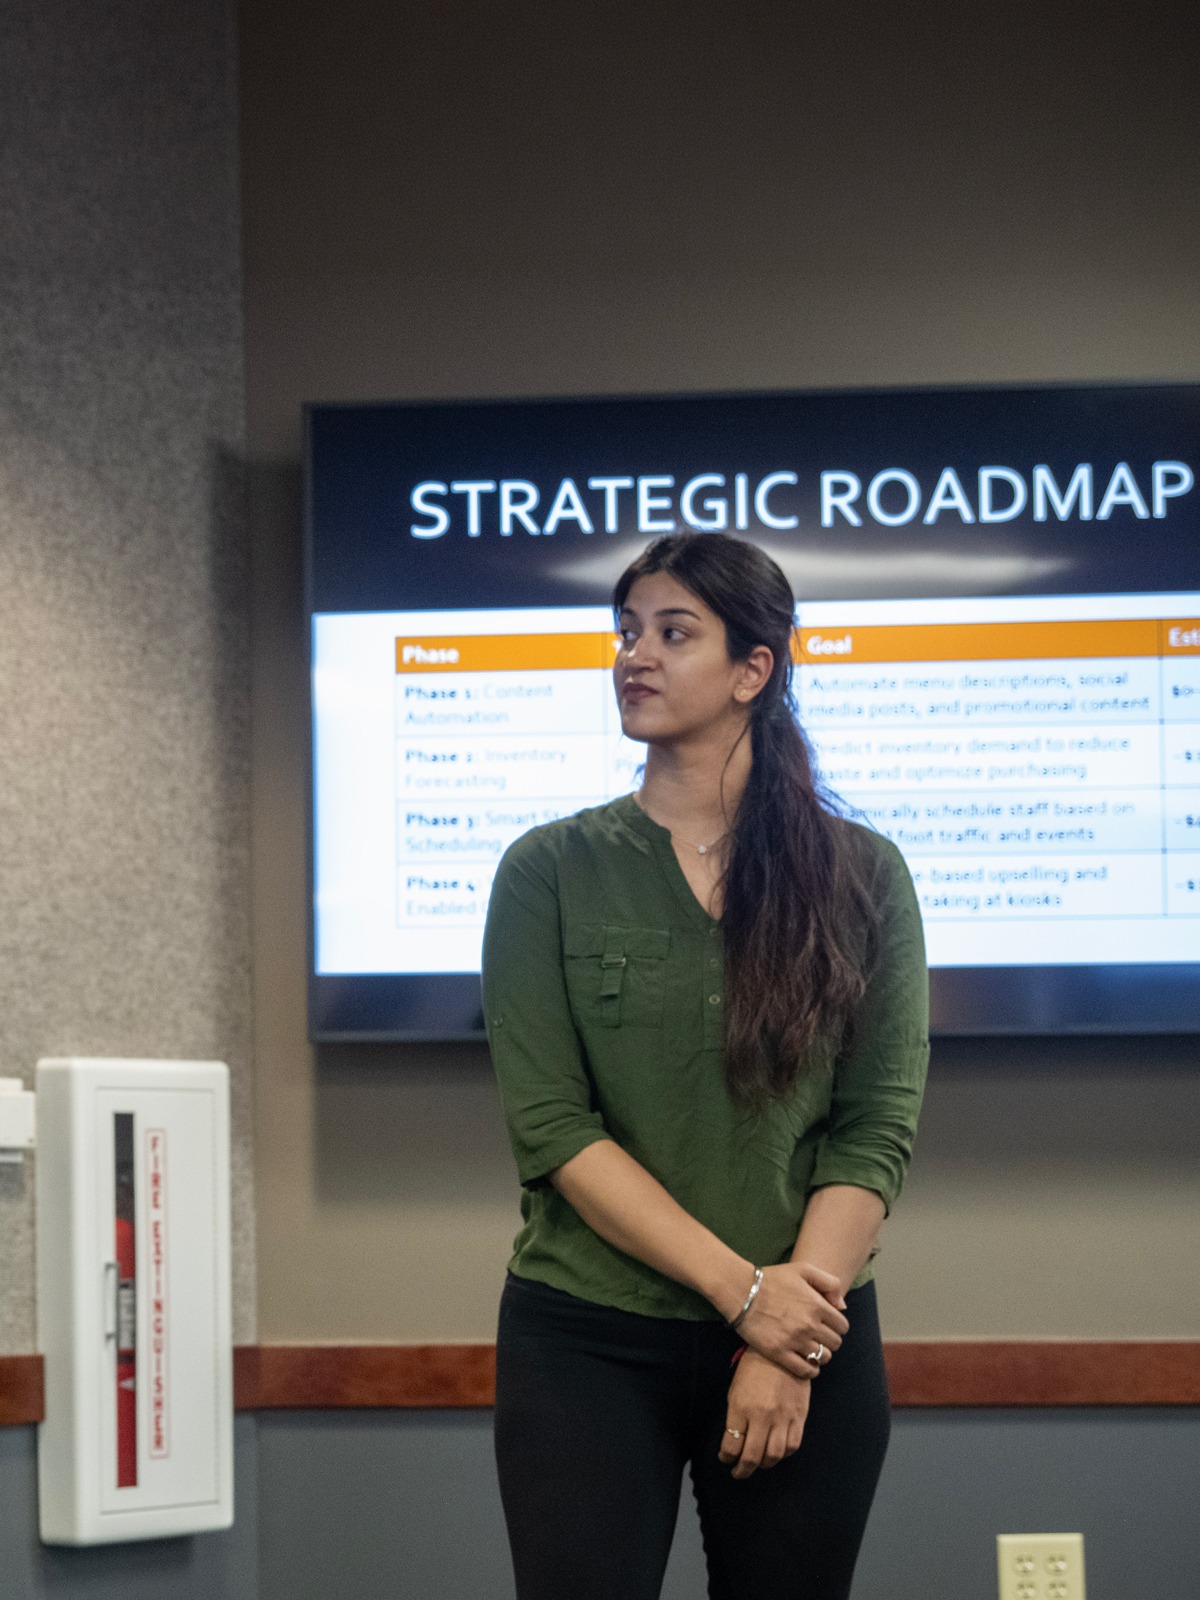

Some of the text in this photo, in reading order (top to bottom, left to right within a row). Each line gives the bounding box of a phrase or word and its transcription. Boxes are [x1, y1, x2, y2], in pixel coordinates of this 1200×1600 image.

[409, 461, 1195, 539] STRATEGIC ROADMAP
[402, 645, 460, 664] Phase
[806, 634, 853, 655] Goal
[808, 669, 1129, 692] Automate menu descriptions, social
[405, 685, 458, 700] Phase
[482, 684, 553, 700] Content
[405, 711, 509, 724] Automation
[808, 702, 864, 718] media
[927, 698, 960, 716] and
[964, 696, 1076, 719] promotional
[1078, 697, 1150, 714] content
[877, 739, 962, 757] inventory
[968, 736, 1042, 755] demand
[1045, 737, 1066, 753] to
[1068, 735, 1131, 752] reduce
[405, 748, 459, 764] Phase
[485, 748, 567, 765] Inventory
[405, 774, 507, 791] Forecasting
[867, 764, 901, 781] and
[904, 764, 982, 783] optimize
[987, 762, 1088, 784] purchasing
[405, 811, 460, 826] Phase
[484, 809, 537, 825] Smart
[924, 799, 1003, 818] schedule
[1008, 800, 1049, 817] staff
[1053, 798, 1109, 817] based
[1112, 802, 1136, 816] on
[405, 836, 503, 854] Scheduling
[897, 826, 934, 845] foot
[938, 825, 991, 844] traffic
[997, 825, 1031, 843] and
[1035, 825, 1095, 843] events
[406, 875, 461, 890] Phase
[988, 864, 1070, 886] upselling
[1074, 863, 1109, 882] and
[406, 900, 477, 916] Enabled
[922, 890, 1064, 912] taking at kiosks
[150, 1135, 164, 1451] FIRE EXTINGUISHER
